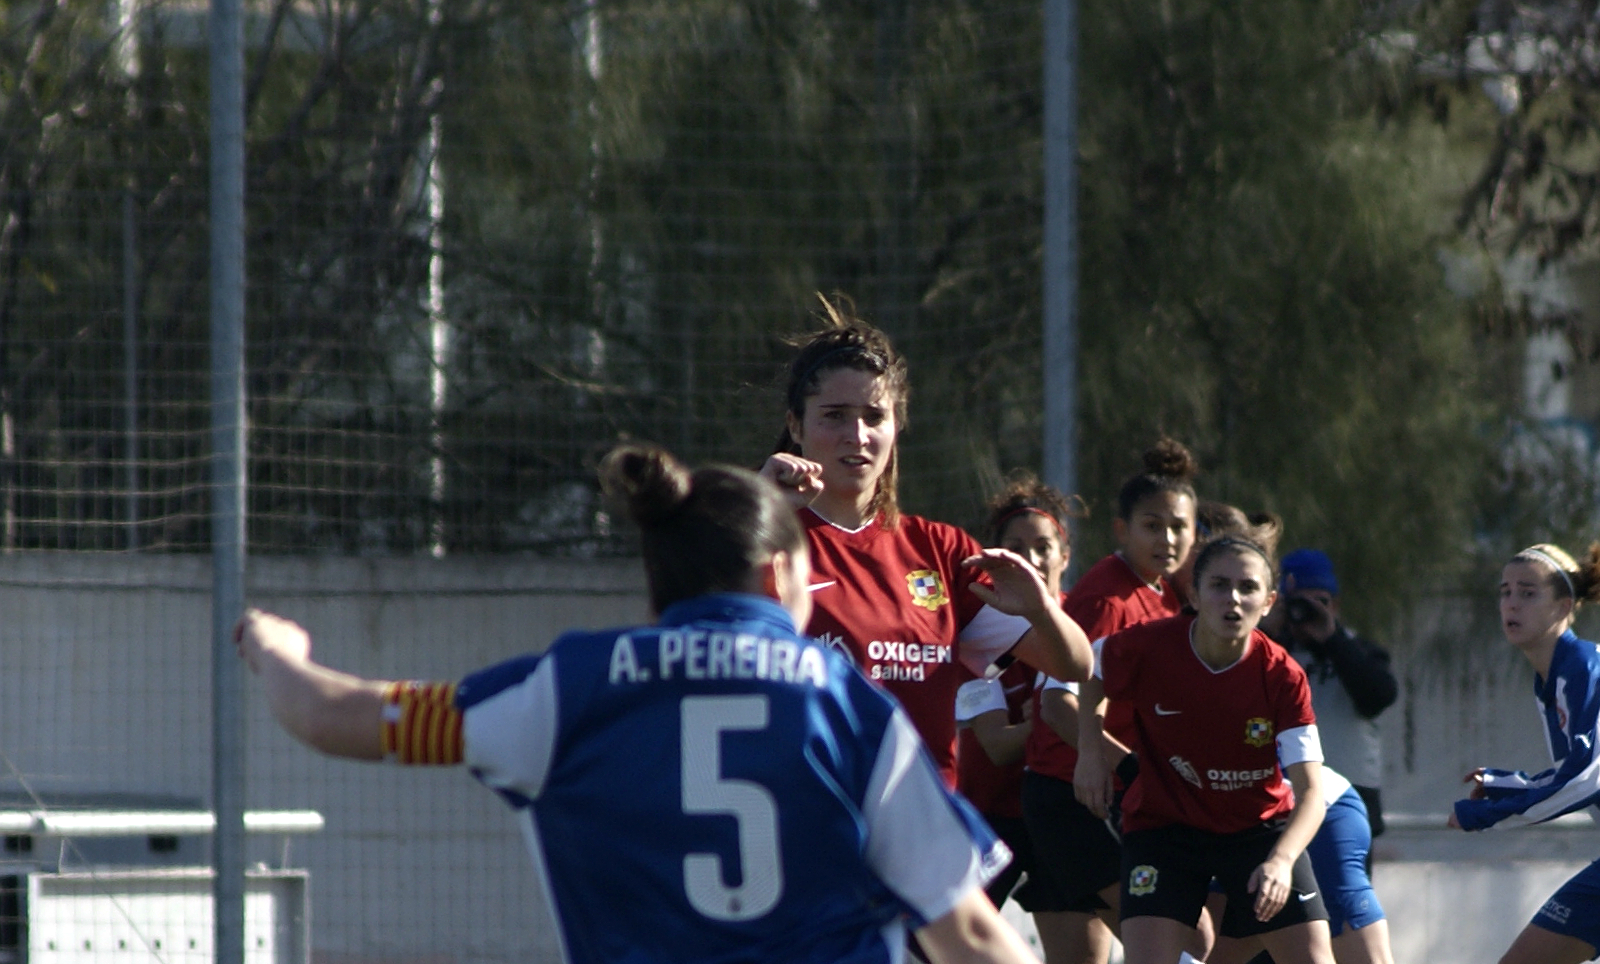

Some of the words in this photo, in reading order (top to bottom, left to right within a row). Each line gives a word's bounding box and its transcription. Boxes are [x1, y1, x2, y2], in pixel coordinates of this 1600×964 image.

[608, 633, 650, 684] A.
[658, 630, 828, 688] PEREIRA
[867, 640, 952, 663] OXIGEN
[870, 664, 925, 682] salud
[1207, 766, 1275, 781] OXIGEN
[680, 694, 784, 922] 5
